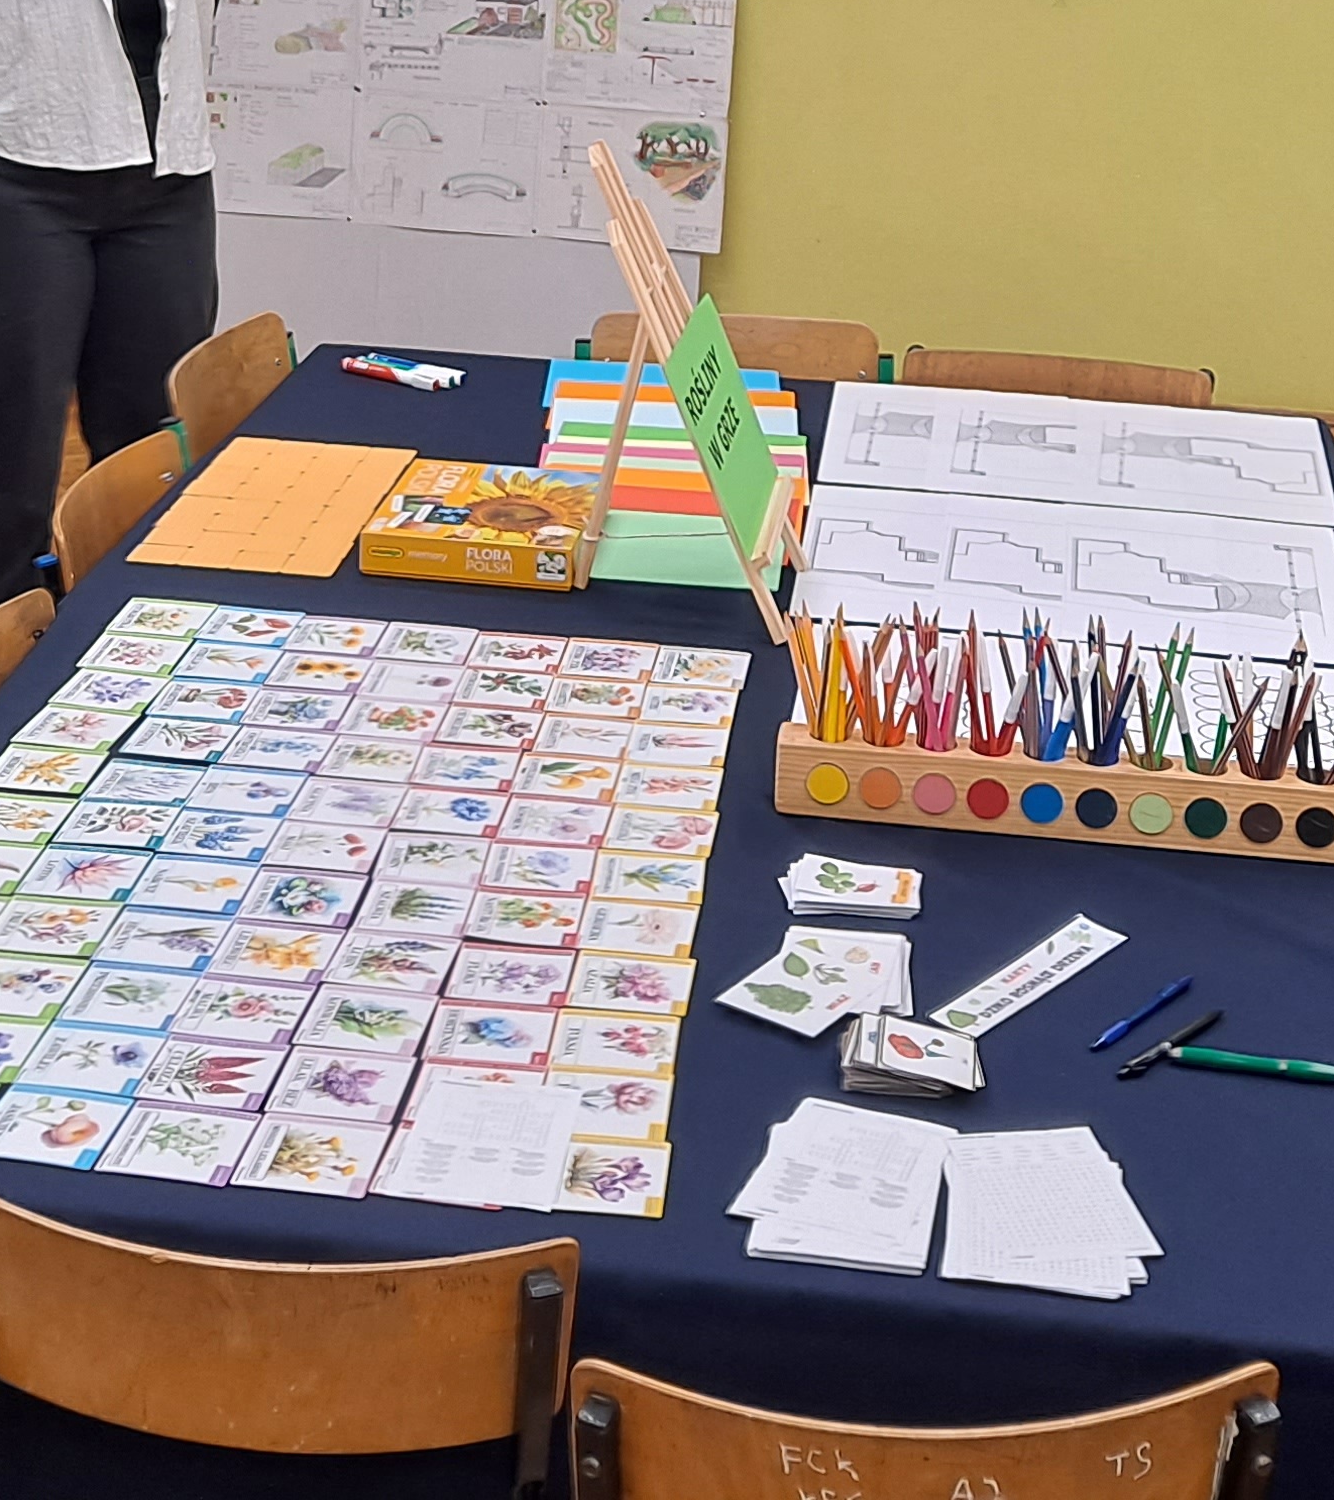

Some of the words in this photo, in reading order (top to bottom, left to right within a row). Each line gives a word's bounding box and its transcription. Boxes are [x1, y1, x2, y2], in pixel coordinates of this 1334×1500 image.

[684, 344, 721, 427] ROŚLINY
[708, 434, 724, 471] W
[716, 396, 740, 452] GRZE
[466, 547, 512, 560] FLORA
[466, 559, 513, 575] POLSKI
[34, 859, 60, 881] LOTOS
[580, 969, 598, 993] AZALIA
[152, 1050, 185, 1087] CELOZJA
[1105, 1441, 1152, 1481] TS
